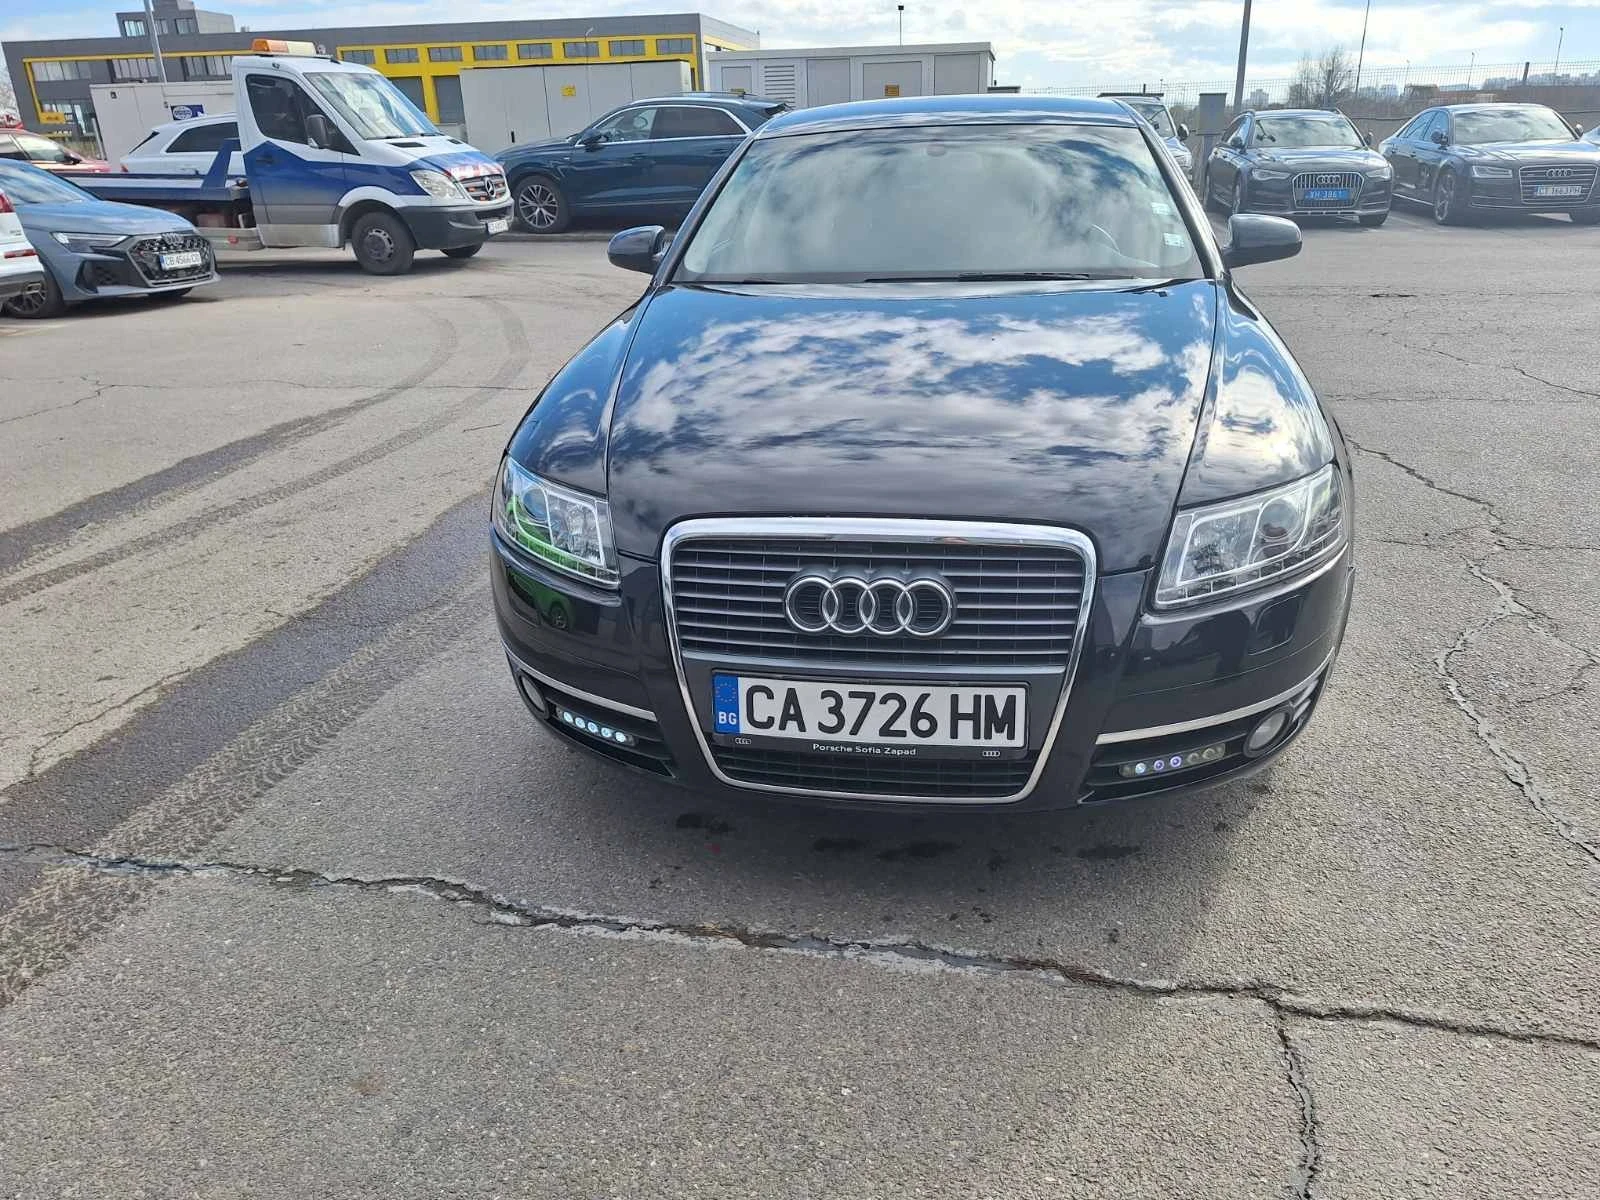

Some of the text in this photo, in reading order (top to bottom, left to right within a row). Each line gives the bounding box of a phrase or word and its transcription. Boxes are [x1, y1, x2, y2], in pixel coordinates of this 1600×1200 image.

[718, 711, 737, 725] BG
[746, 685, 1016, 740] CA 3726 HM
[812, 743, 917, 756] Porsche Sofia Zapad
